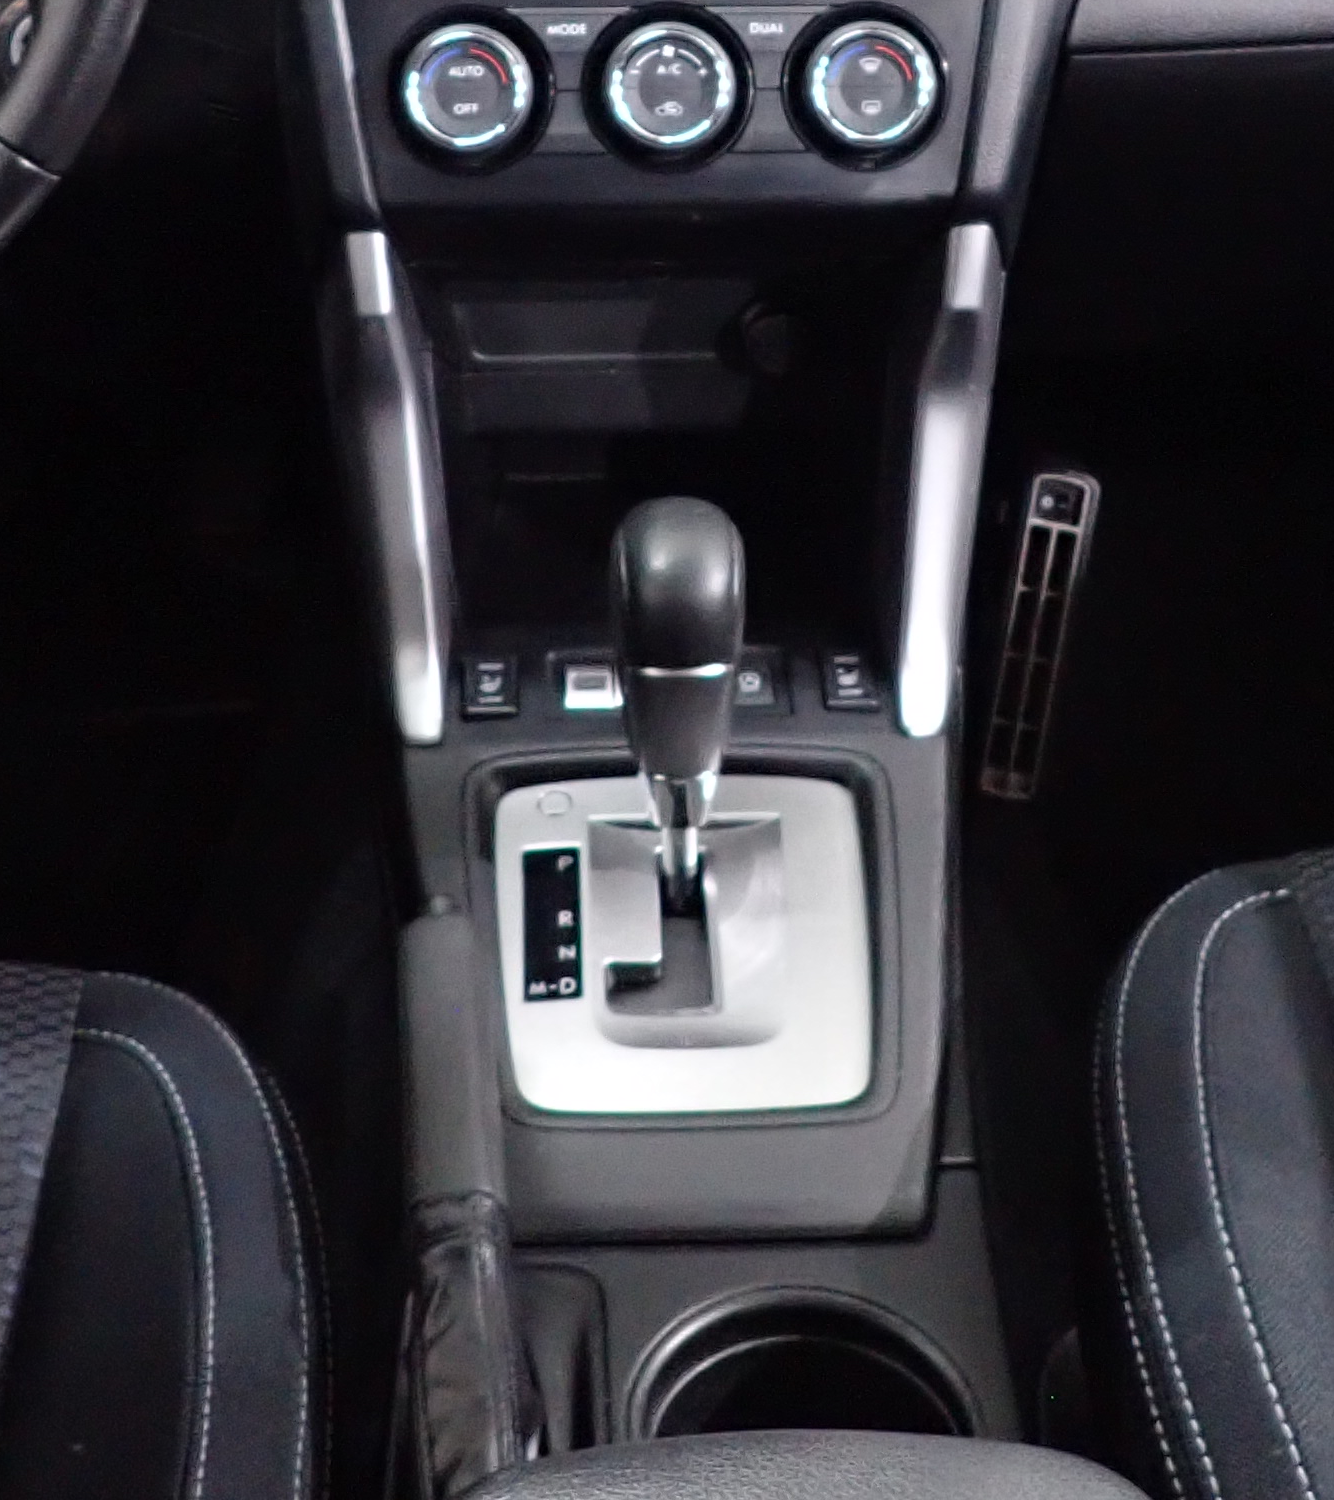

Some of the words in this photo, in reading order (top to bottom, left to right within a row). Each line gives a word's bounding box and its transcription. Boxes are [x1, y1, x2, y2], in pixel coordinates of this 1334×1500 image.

[546, 23, 587, 35] MODE
[749, 22, 784, 34] DUAL
[448, 65, 485, 77] AUTO
[656, 64, 683, 75] A/C
[453, 102, 479, 115] OFF
[557, 854, 574, 872] P
[557, 908, 574, 927] R
[558, 944, 577, 962] N
